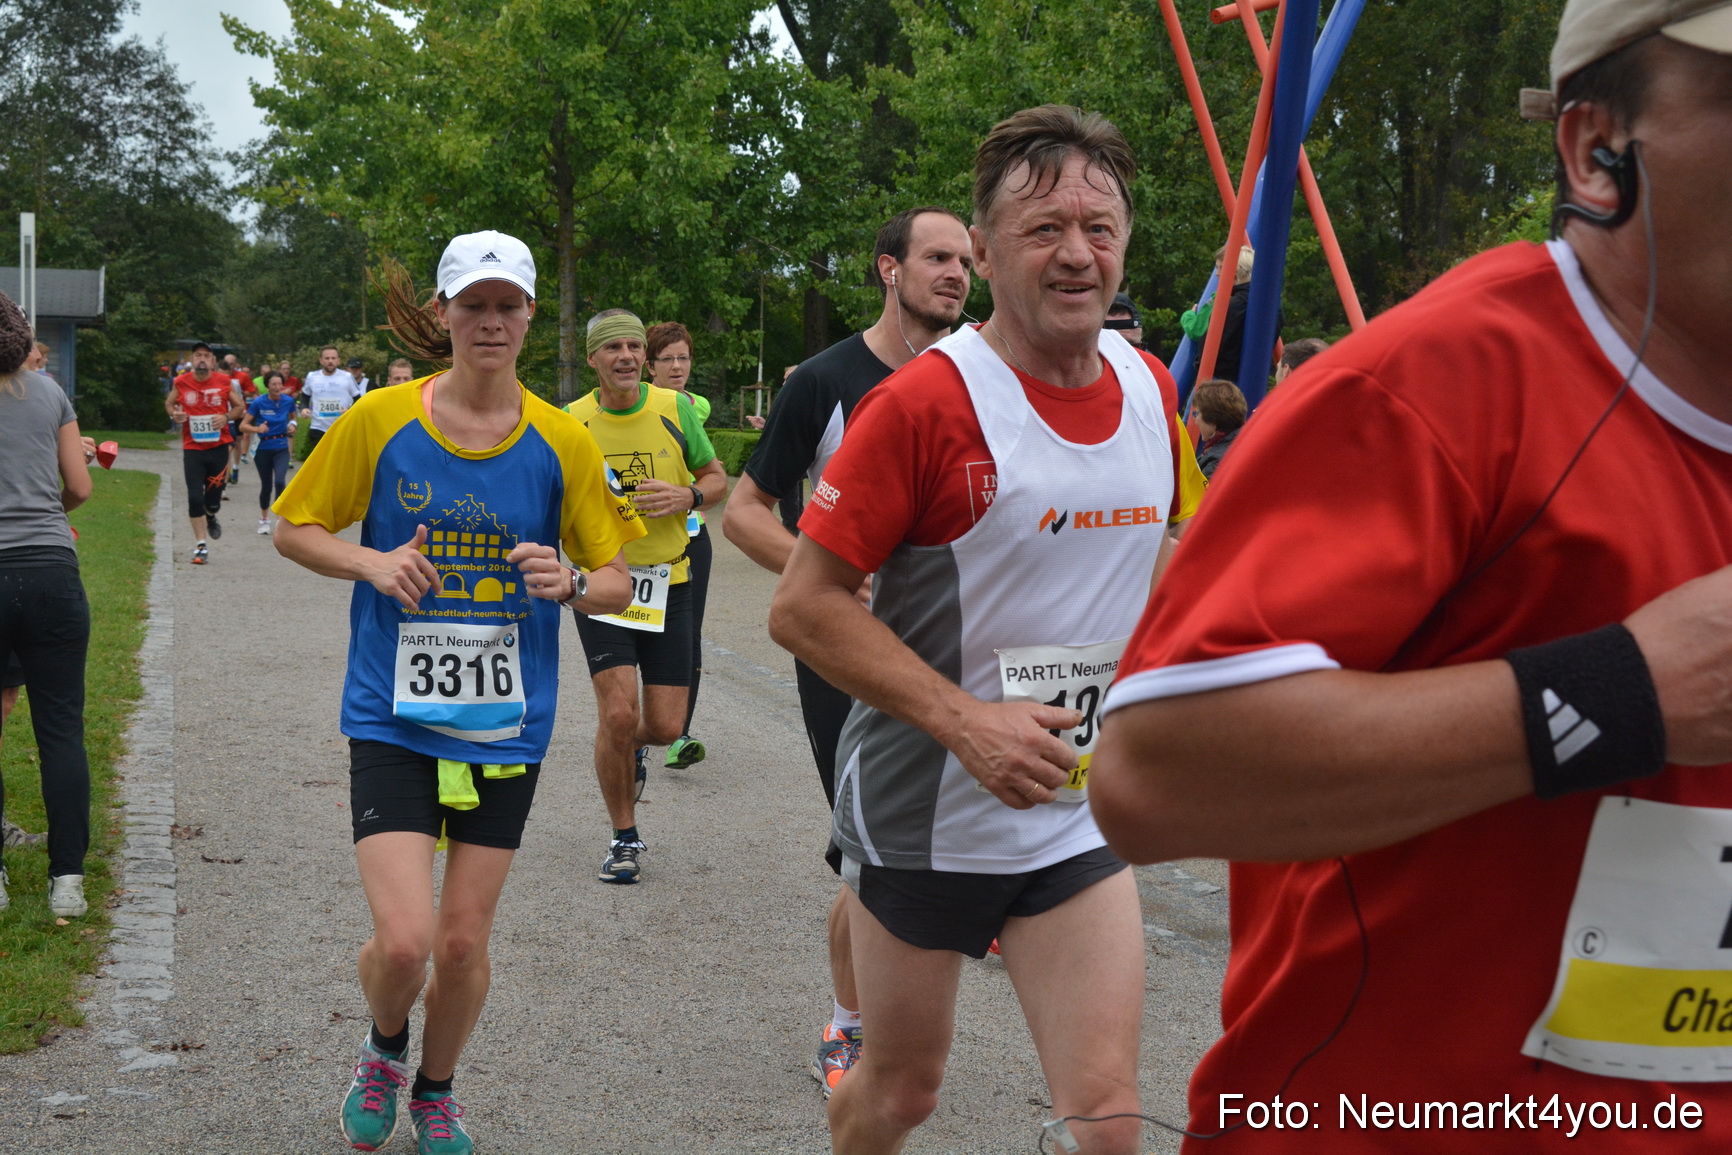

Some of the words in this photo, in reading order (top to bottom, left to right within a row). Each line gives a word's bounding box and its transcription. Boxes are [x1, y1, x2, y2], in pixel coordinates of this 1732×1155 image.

[320, 403, 340, 412] 2404
[193, 422, 218, 432] 331
[409, 482, 419, 490] 15
[403, 492, 424, 500] Jahre
[1073, 505, 1163, 530] KLEBL
[433, 562, 486, 572] September
[488, 564, 512, 572] 2014
[400, 635, 443, 647] PARTL
[446, 636, 501, 648] Neumarkt
[409, 652, 513, 698] 3316
[1005, 663, 1067, 682] PARTL
